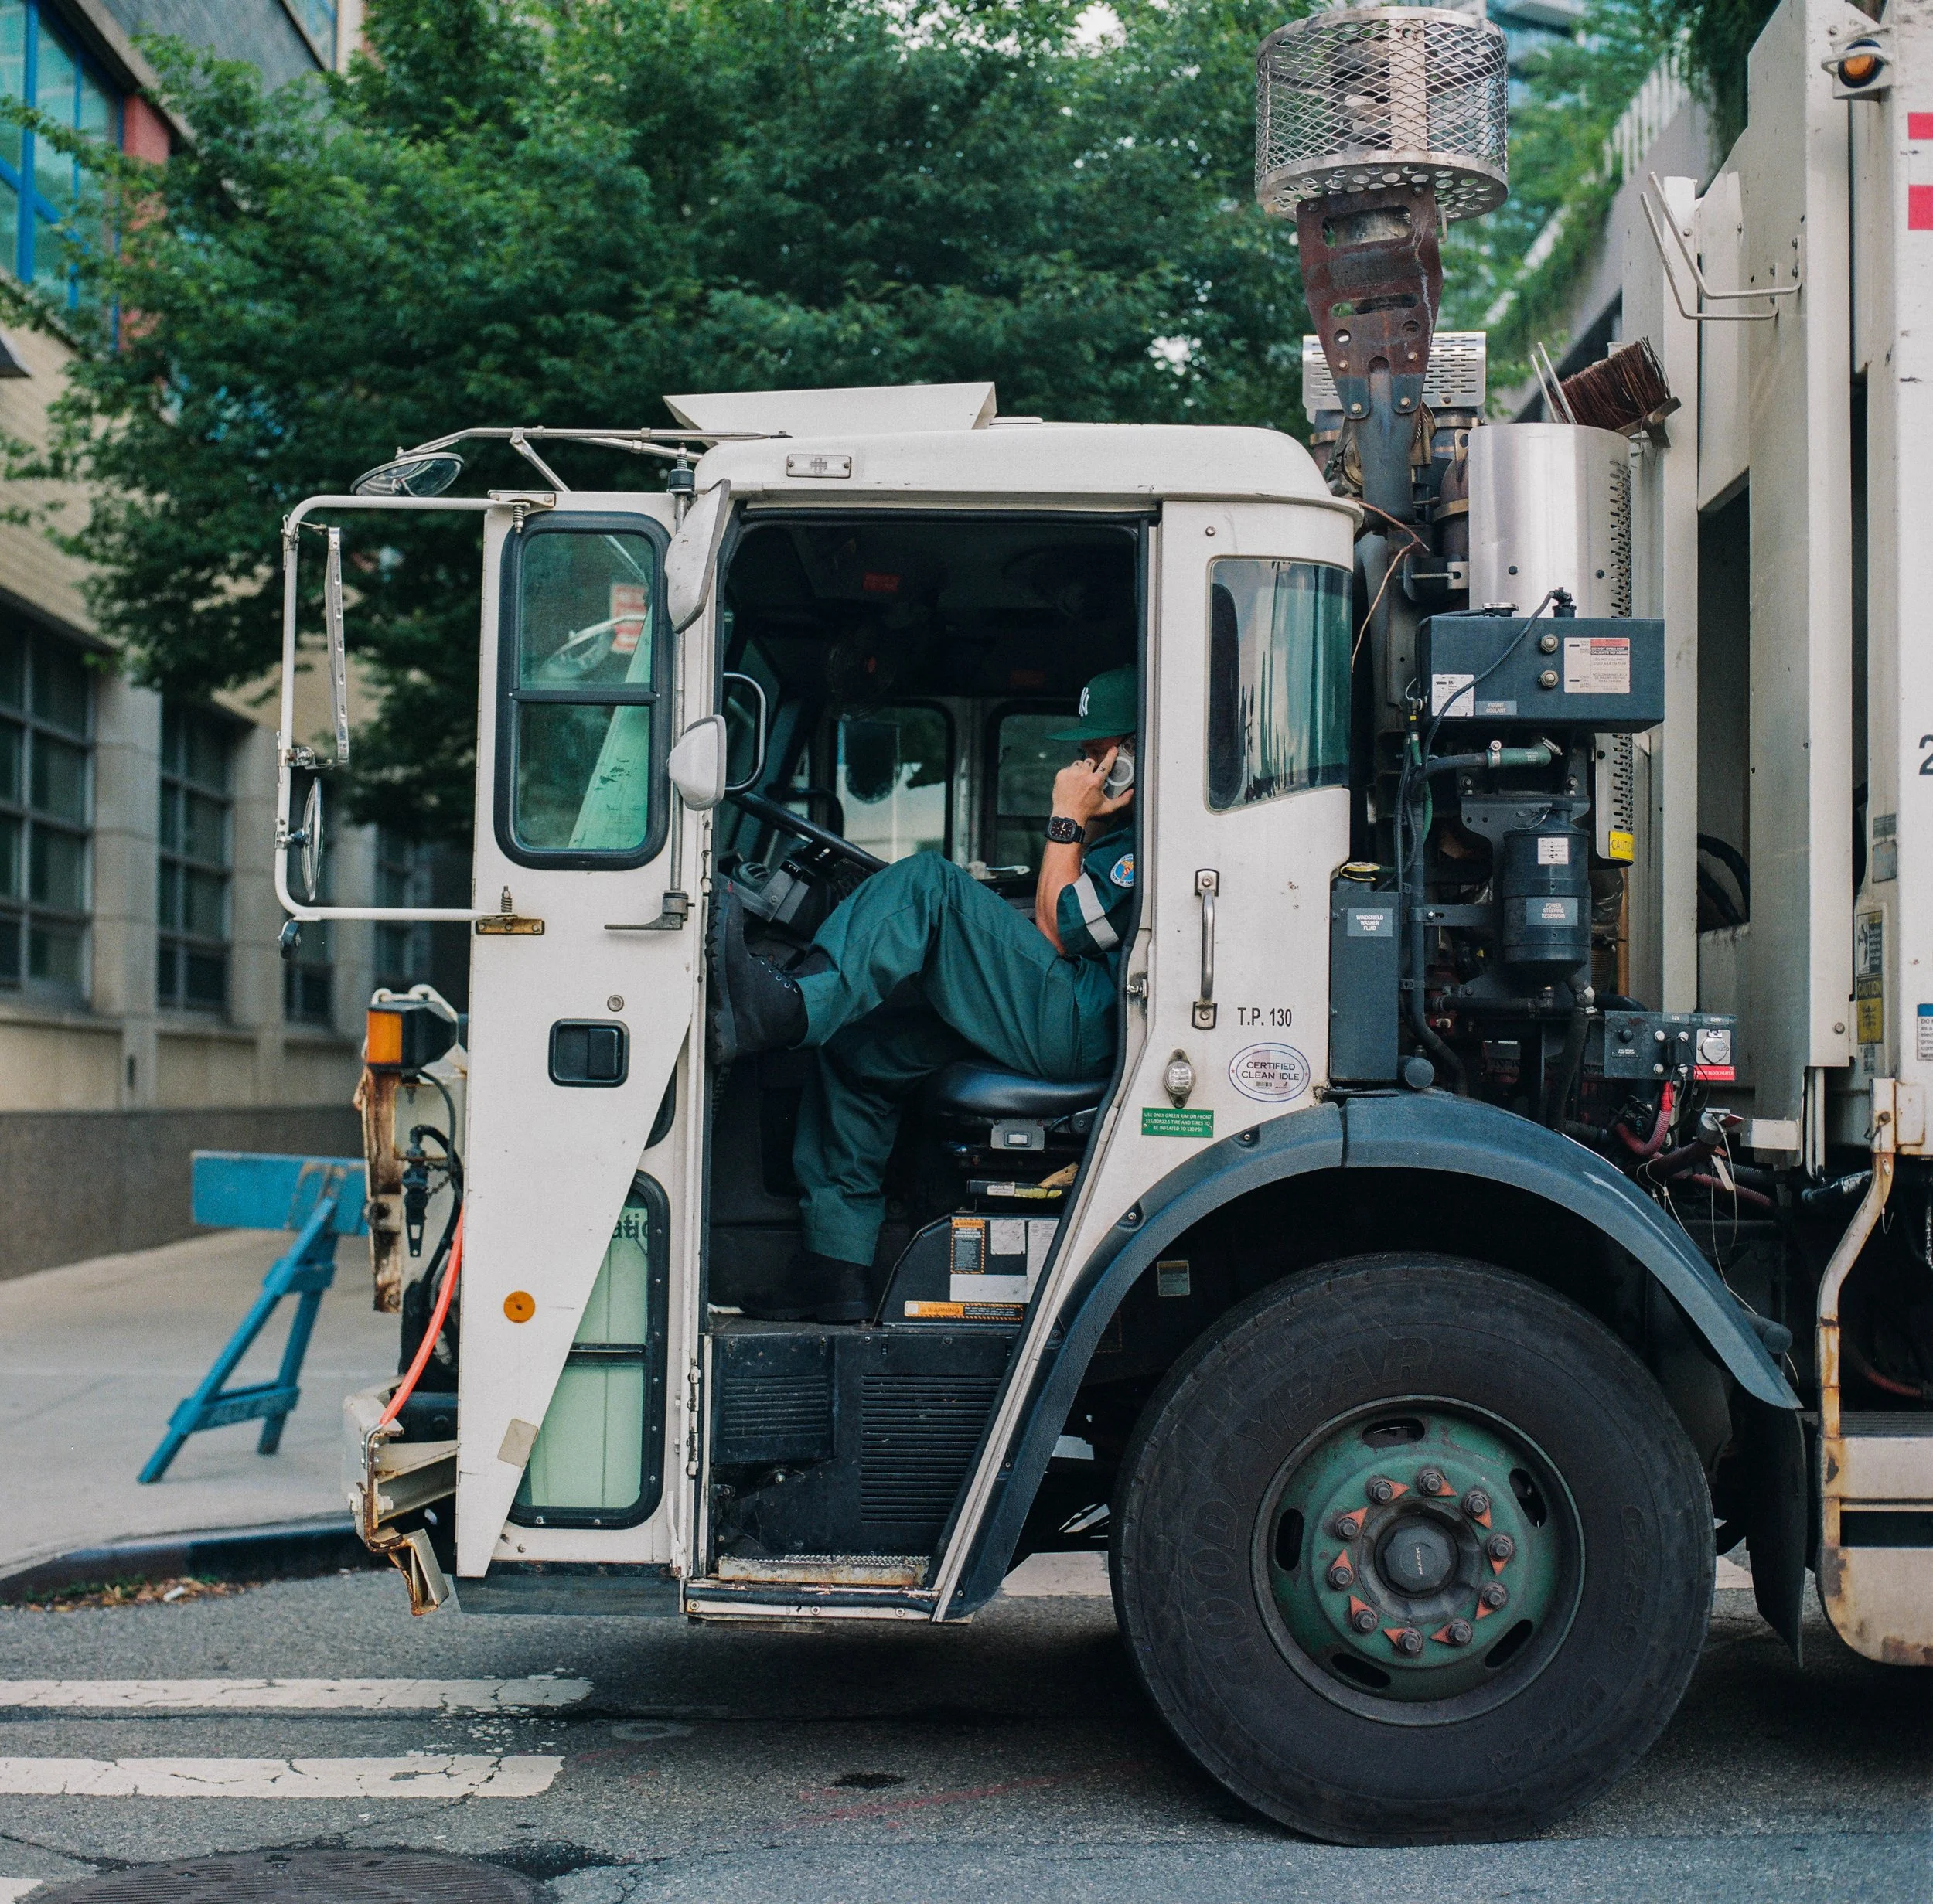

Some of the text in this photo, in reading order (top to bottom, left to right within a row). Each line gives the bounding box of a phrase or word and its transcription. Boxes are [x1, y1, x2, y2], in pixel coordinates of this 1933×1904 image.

[1238, 1007, 1291, 1027] T.P. 130
[1415, 1546, 1423, 1575] MACK
